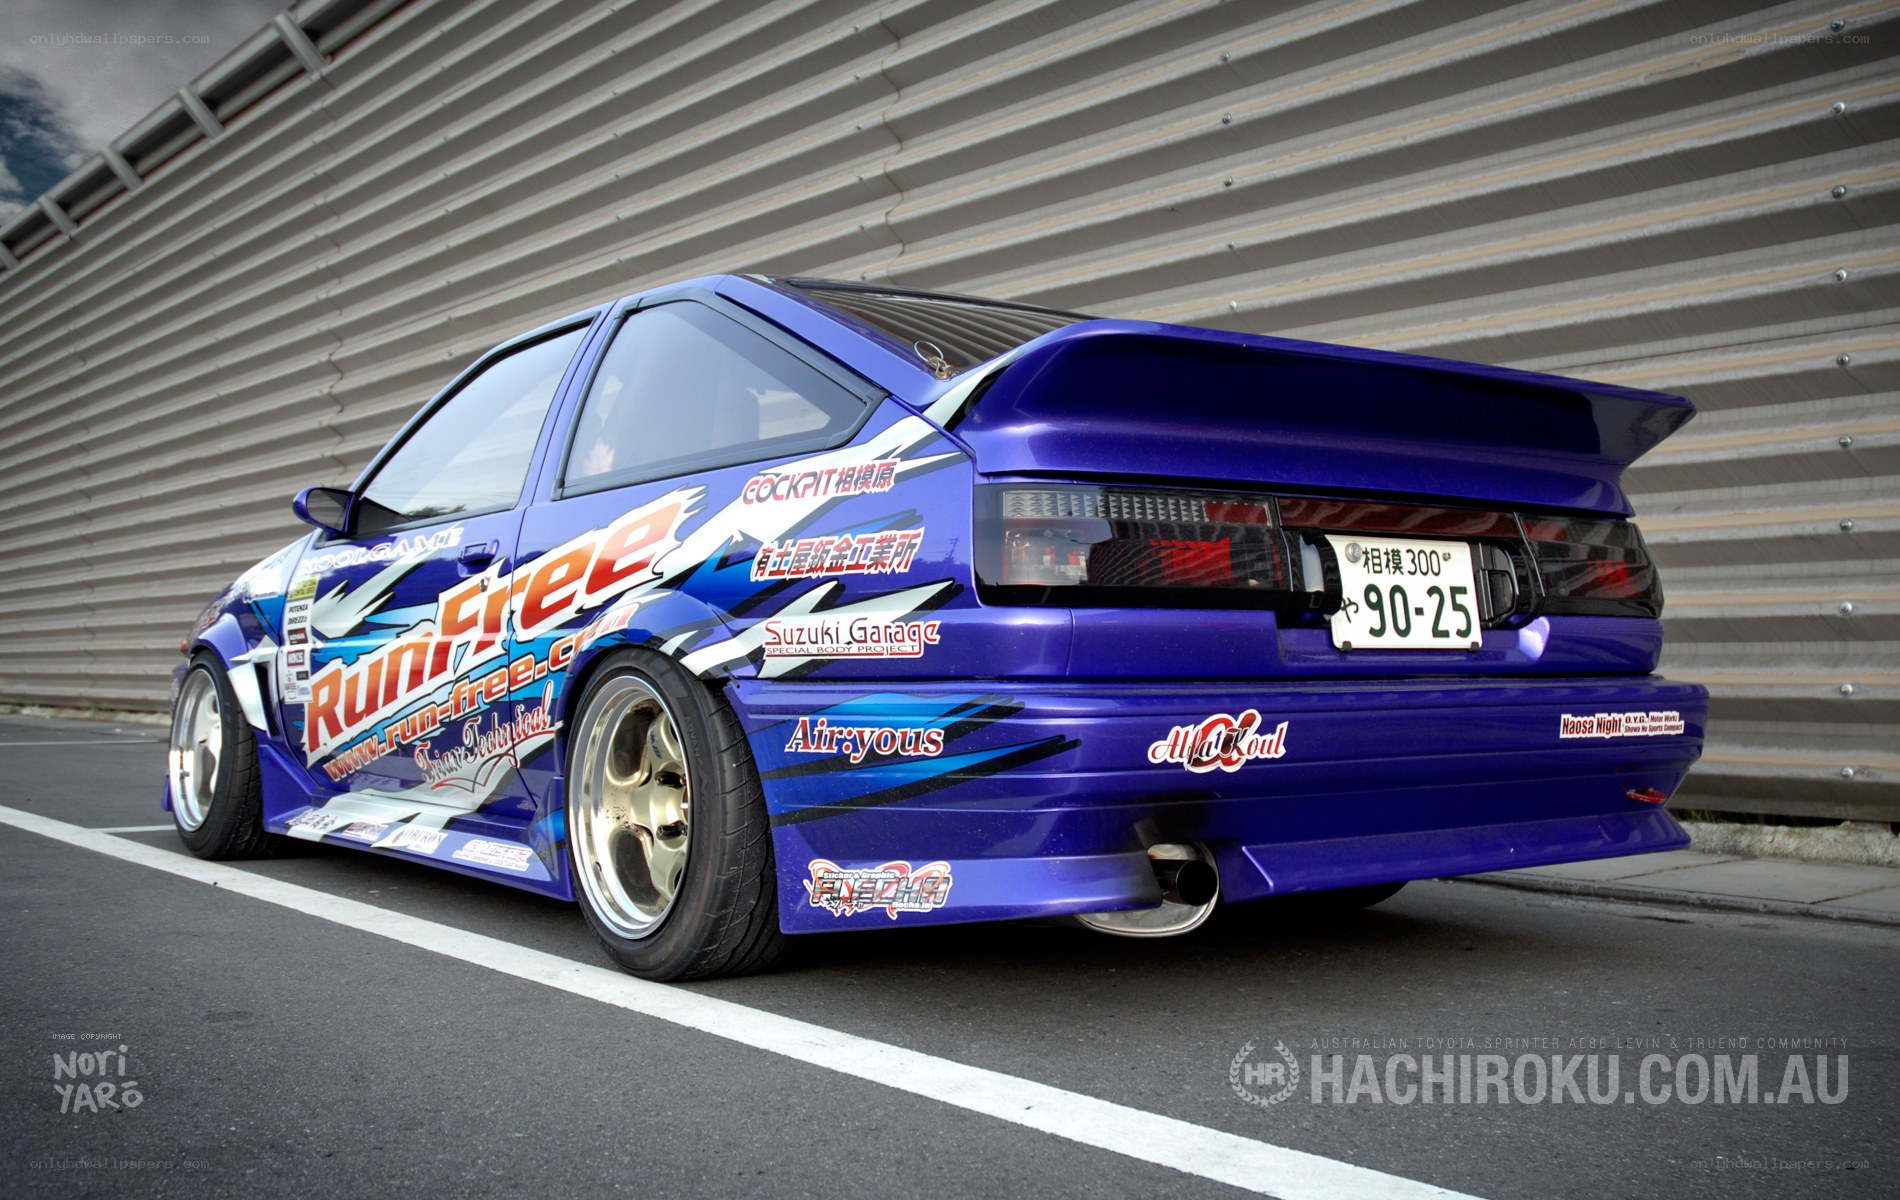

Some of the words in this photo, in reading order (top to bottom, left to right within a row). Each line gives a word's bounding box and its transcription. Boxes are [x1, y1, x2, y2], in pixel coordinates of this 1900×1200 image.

[1362, 547, 1404, 575] 相模
[1406, 549, 1441, 576] 300
[1364, 583, 1472, 638] 90-25
[765, 620, 840, 645] Suzuki
[850, 617, 938, 655] Garage
[766, 646, 812, 654] SPECIAL
[816, 645, 853, 653] BODY
[858, 644, 917, 655] PROJECT
[1562, 717, 1593, 735] Naosa
[1596, 716, 1622, 736] Night
[823, 871, 853, 879] Sticker
[861, 871, 896, 880] Graphic
